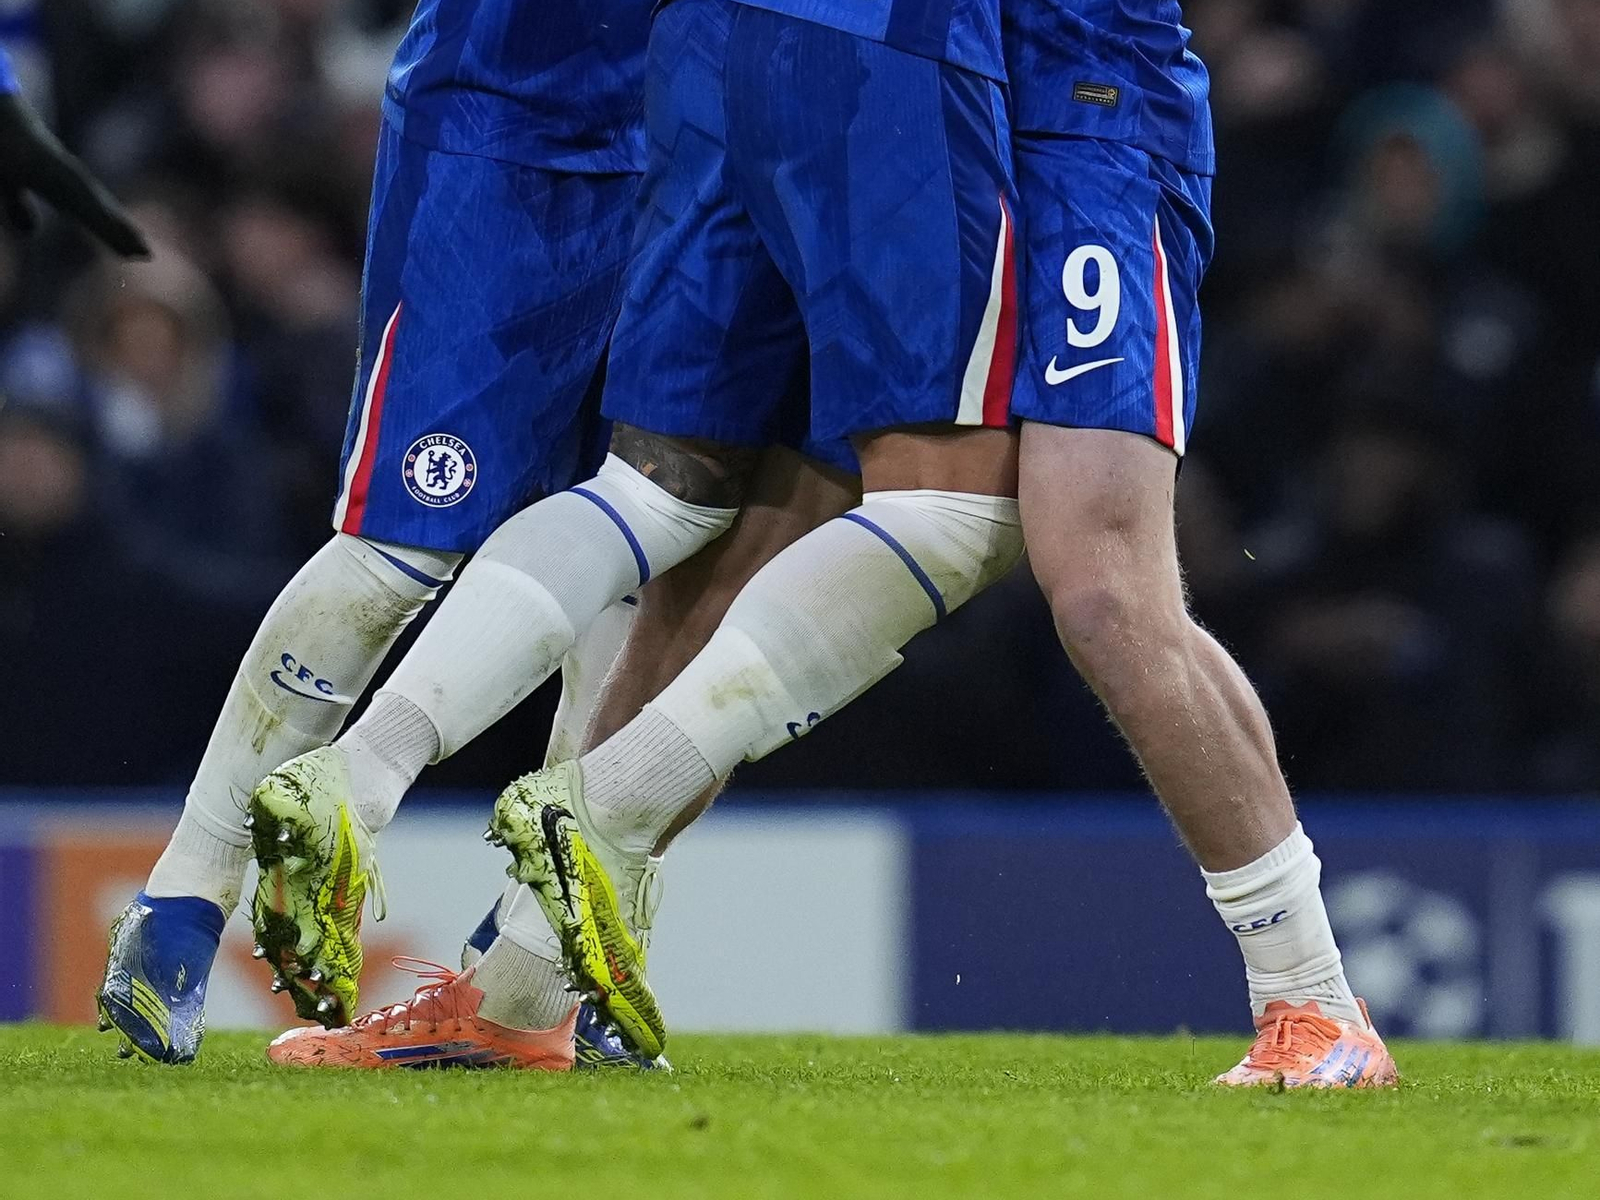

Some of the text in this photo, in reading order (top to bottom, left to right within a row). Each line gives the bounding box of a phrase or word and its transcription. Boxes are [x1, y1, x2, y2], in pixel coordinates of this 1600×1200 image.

[1062, 244, 1121, 349] 9
[419, 436, 467, 456] CHELSEA
[411, 485, 460, 504] FOOTBALL CLUB
[280, 652, 334, 696] CFC
